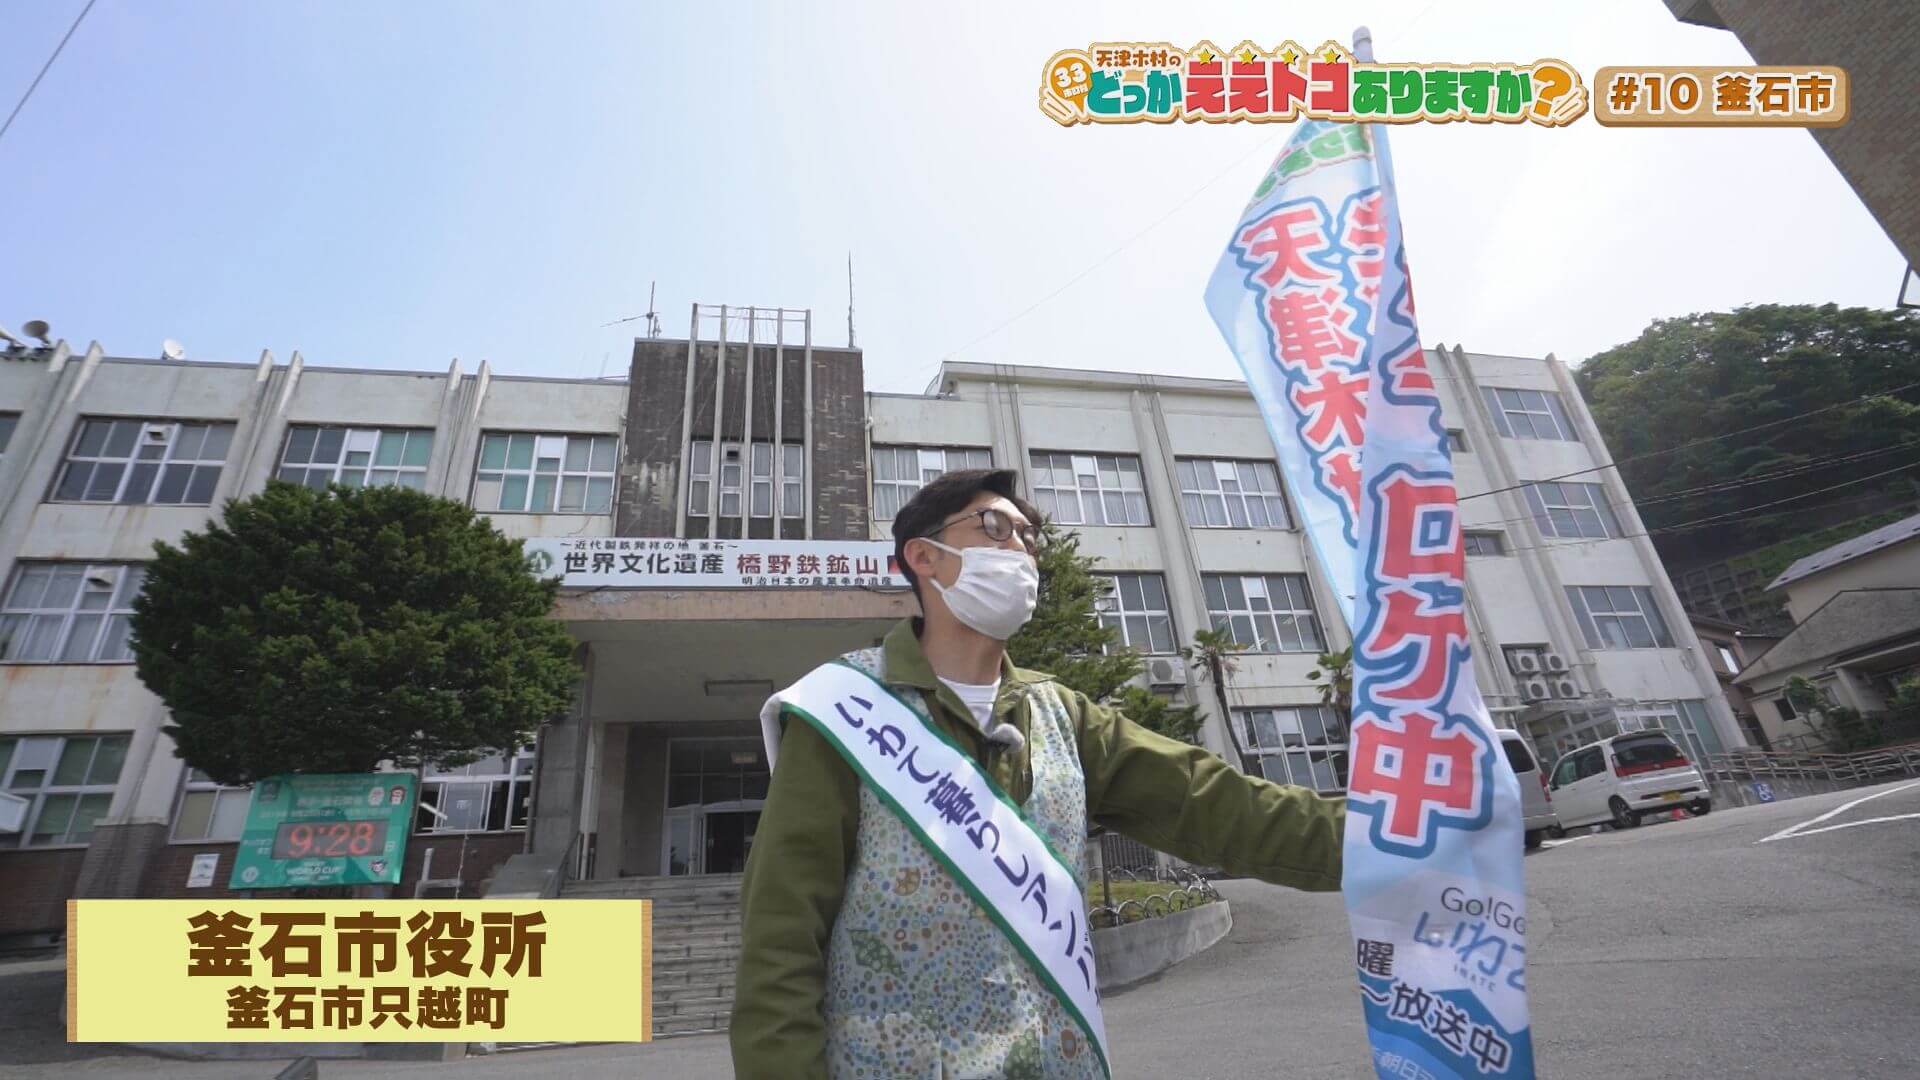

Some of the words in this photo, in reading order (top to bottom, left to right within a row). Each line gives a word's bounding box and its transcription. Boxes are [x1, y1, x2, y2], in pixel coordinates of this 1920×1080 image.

[564, 552, 724, 574] 世界文化遺産
[737, 553, 879, 575] 橋野鉄鉱山
[1351, 477, 1477, 838] ロケ中
[288, 822, 376, 858] 9:28
[835, 695, 1099, 1006] いわて暮らしアンバ
[1357, 938, 1395, 977] 曜
